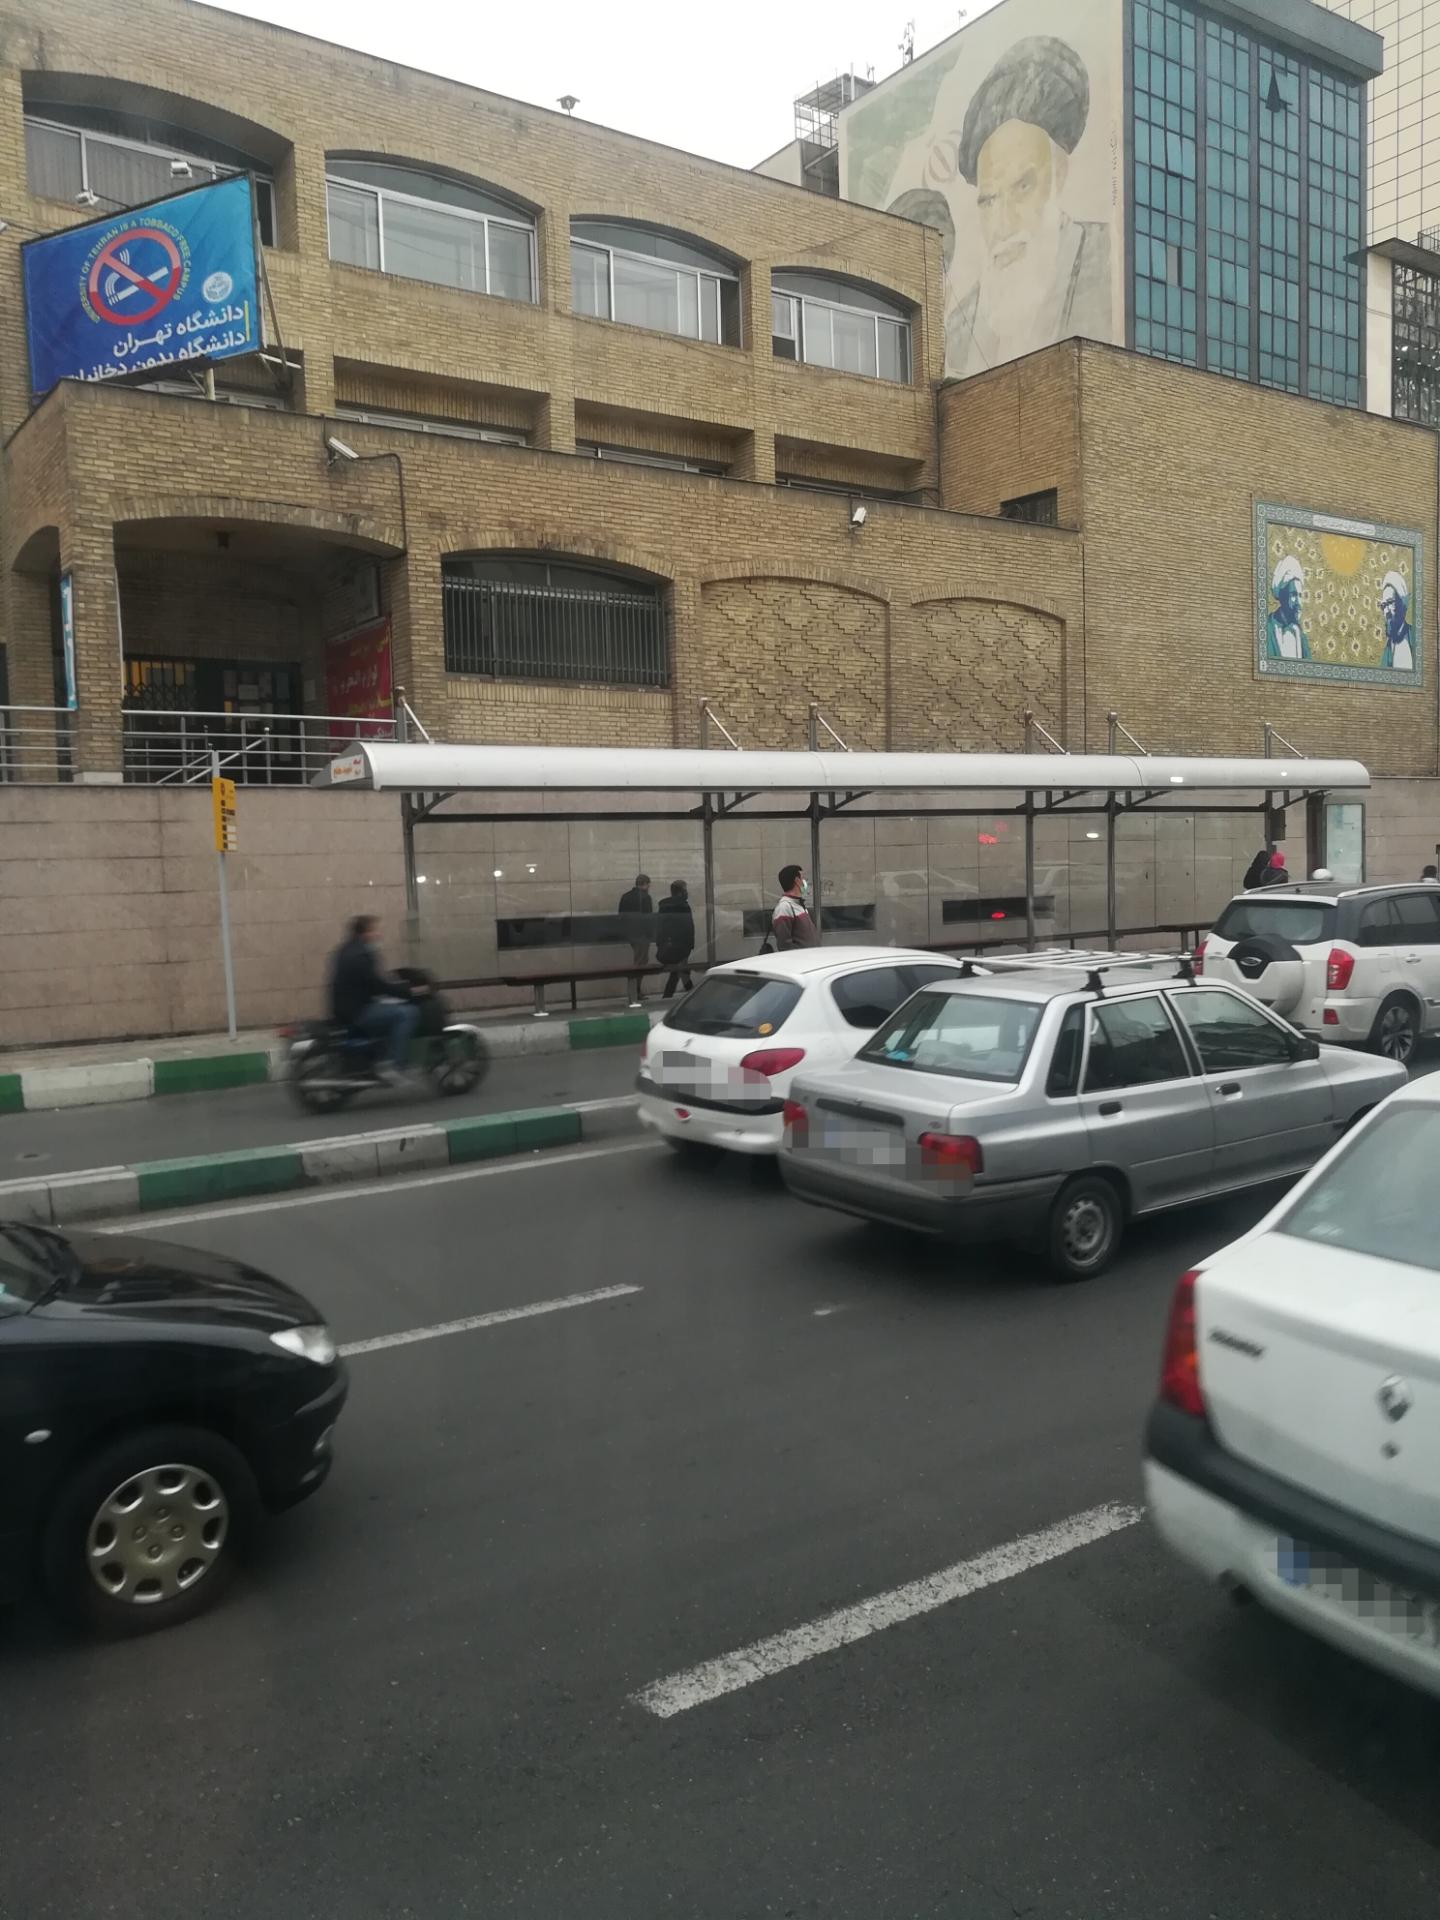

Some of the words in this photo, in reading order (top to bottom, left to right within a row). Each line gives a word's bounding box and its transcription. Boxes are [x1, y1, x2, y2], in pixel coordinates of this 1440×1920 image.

[82, 261, 91, 273] OF
[88, 227, 119, 260] TEHRAN
[120, 223, 129, 232] IS
[172, 260, 191, 301] CAMPUS
[176, 305, 244, 336] دانشگاه
[113, 323, 172, 358] تهران
[179, 331, 246, 361] دانشگاه
[131, 351, 175, 372] بدون
